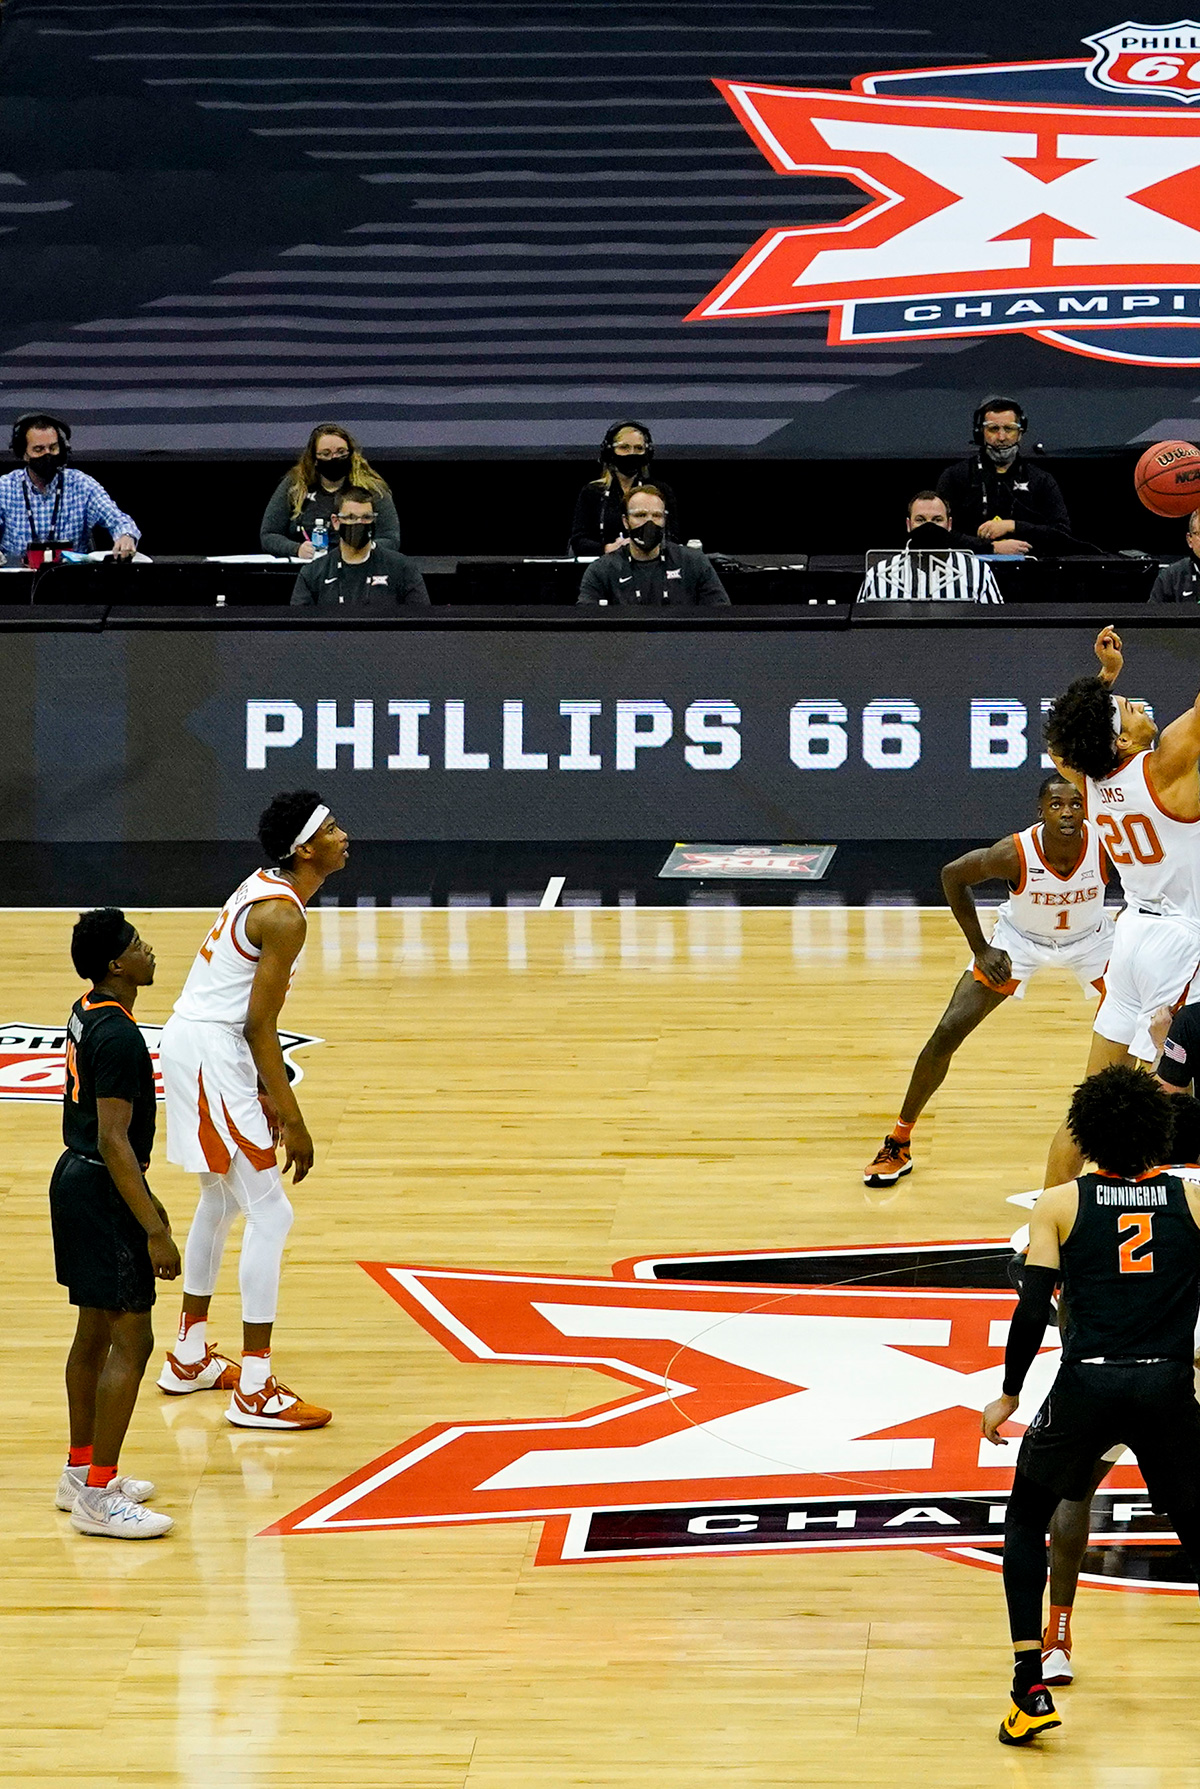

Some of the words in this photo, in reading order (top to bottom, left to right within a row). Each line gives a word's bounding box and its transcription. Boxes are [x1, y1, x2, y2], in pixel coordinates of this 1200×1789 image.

[245, 698, 742, 770] PHILLIPS
[788, 698, 922, 770] 66
[1095, 812, 1166, 866] 20
[1029, 884, 1099, 906] TEXAS
[1053, 908, 1071, 930] 1
[1096, 1184, 1168, 1207] CUNNINGHAM
[1117, 1211, 1155, 1274] 2
